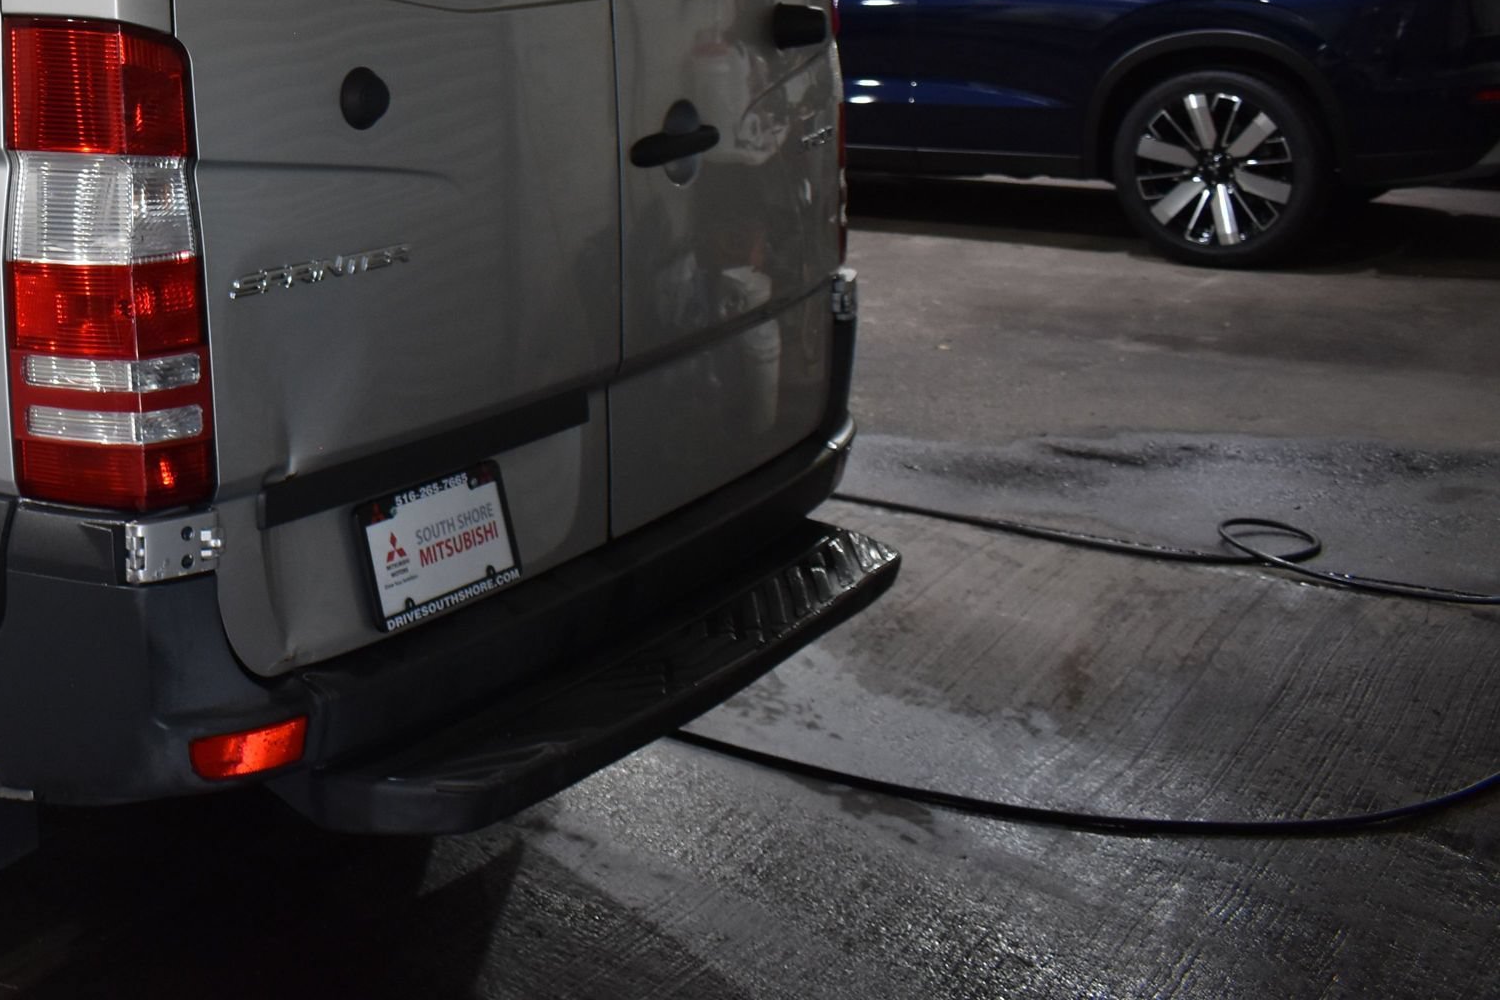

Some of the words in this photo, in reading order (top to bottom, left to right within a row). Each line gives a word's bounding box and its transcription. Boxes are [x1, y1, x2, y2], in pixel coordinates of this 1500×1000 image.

[415, 520, 455, 546] SOUTH
[457, 502, 495, 530] SHORE
[418, 520, 500, 568] MITSUBISHI
[386, 568, 521, 632] DRIVESOUTHSHORE.COM
